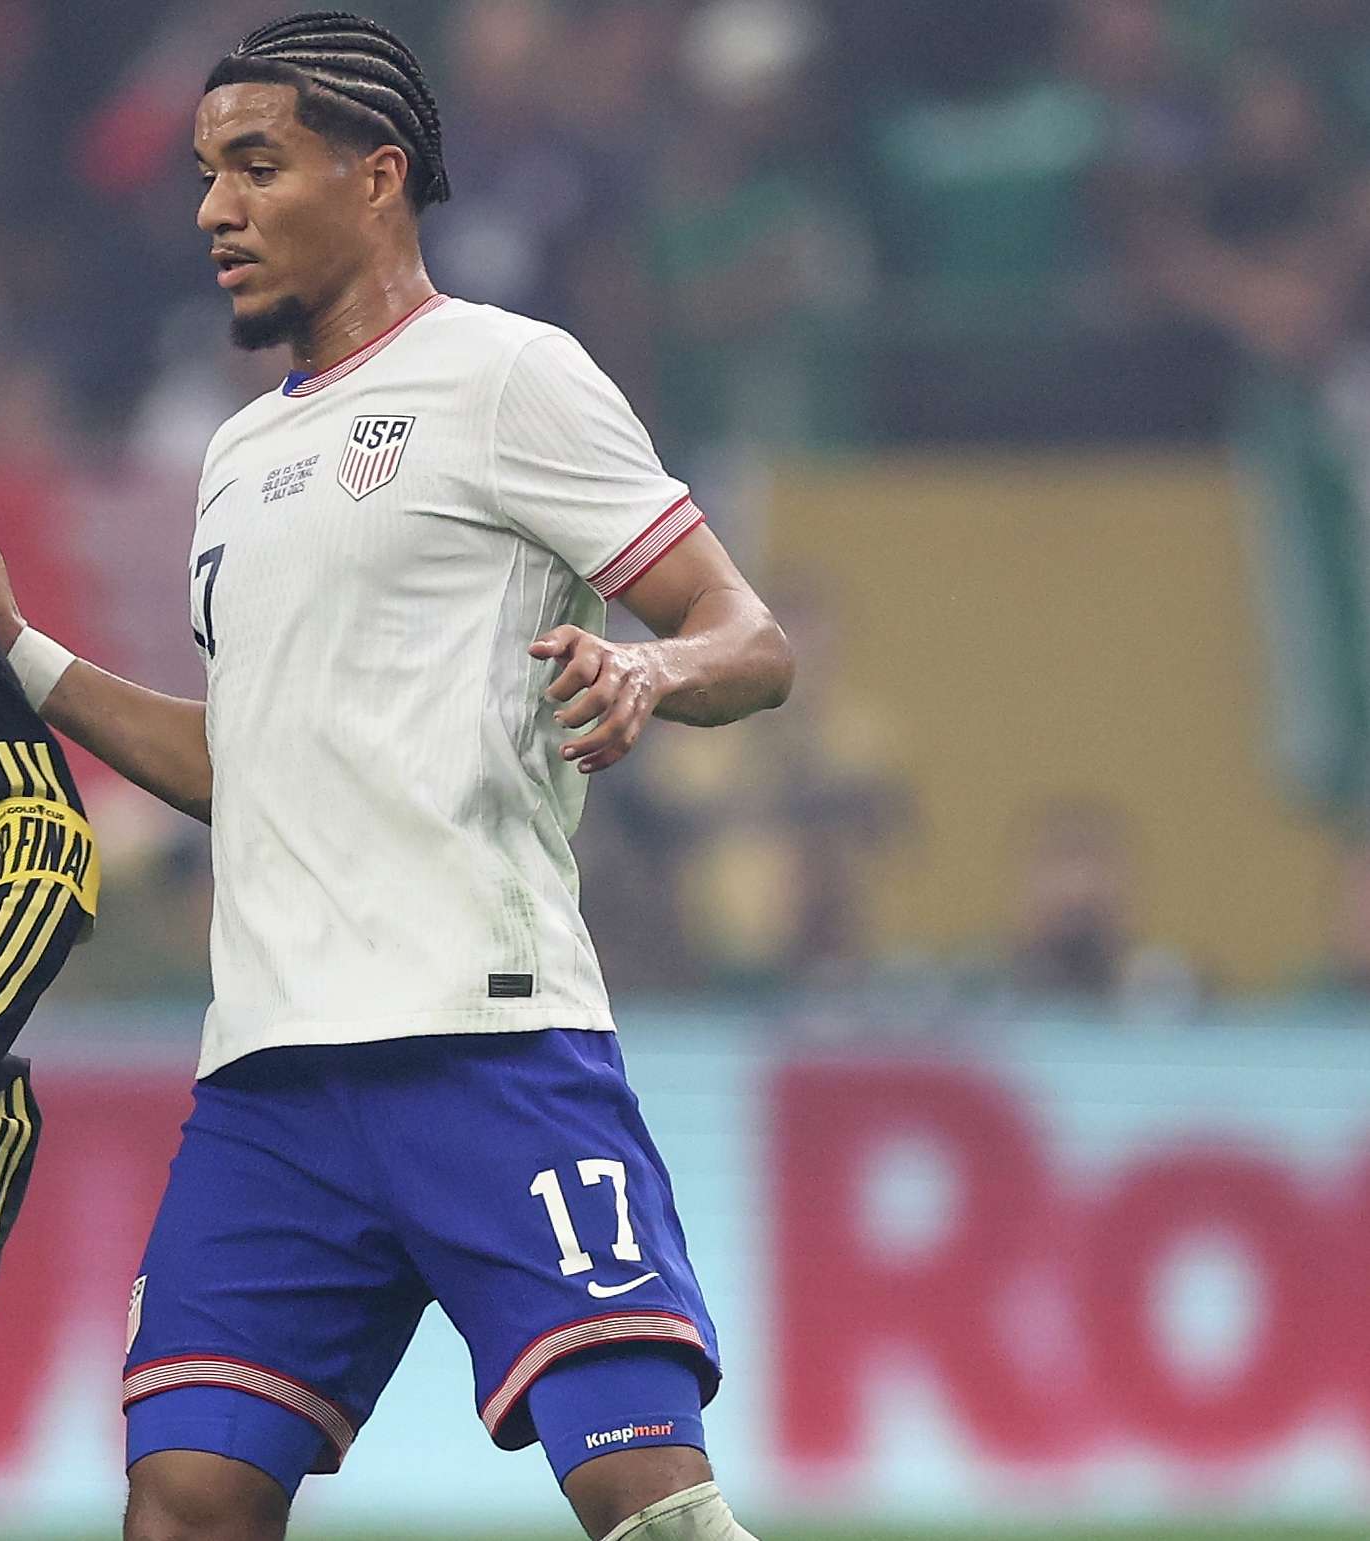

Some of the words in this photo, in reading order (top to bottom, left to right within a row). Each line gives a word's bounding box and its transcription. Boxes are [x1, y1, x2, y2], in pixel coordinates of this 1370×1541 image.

[352, 420, 408, 450] USA
[193, 543, 226, 660] 7
[7, 805, 37, 815] GOLD
[45, 809, 65, 821] CUP
[10, 816, 92, 893] FINAL
[529, 1158, 642, 1276] 17
[770, 1062, 1370, 1468] Ro
